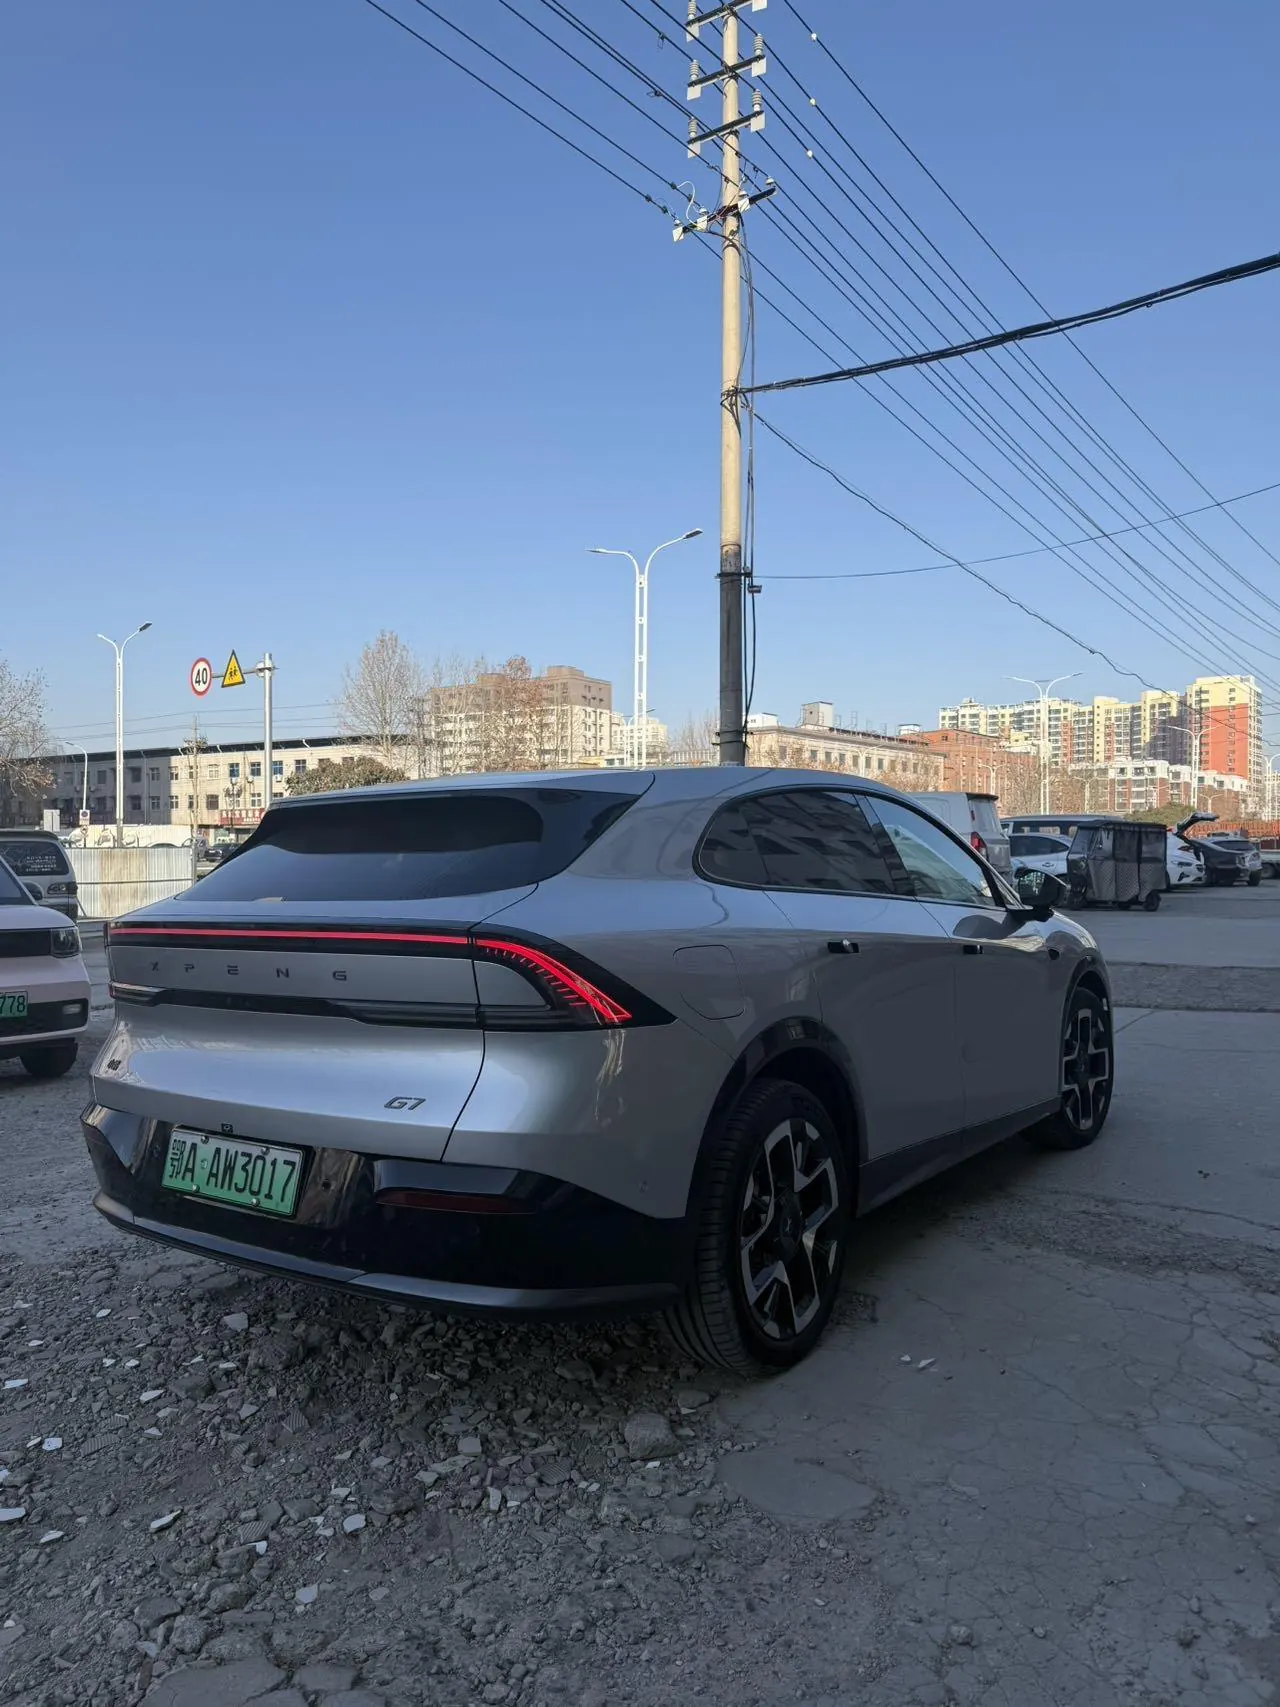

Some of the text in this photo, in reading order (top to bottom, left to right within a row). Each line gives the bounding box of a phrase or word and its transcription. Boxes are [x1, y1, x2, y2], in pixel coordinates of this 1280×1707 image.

[195, 668, 208, 686] 40
[151, 962, 347, 981] XPENG
[384, 1097, 426, 1110] G7
